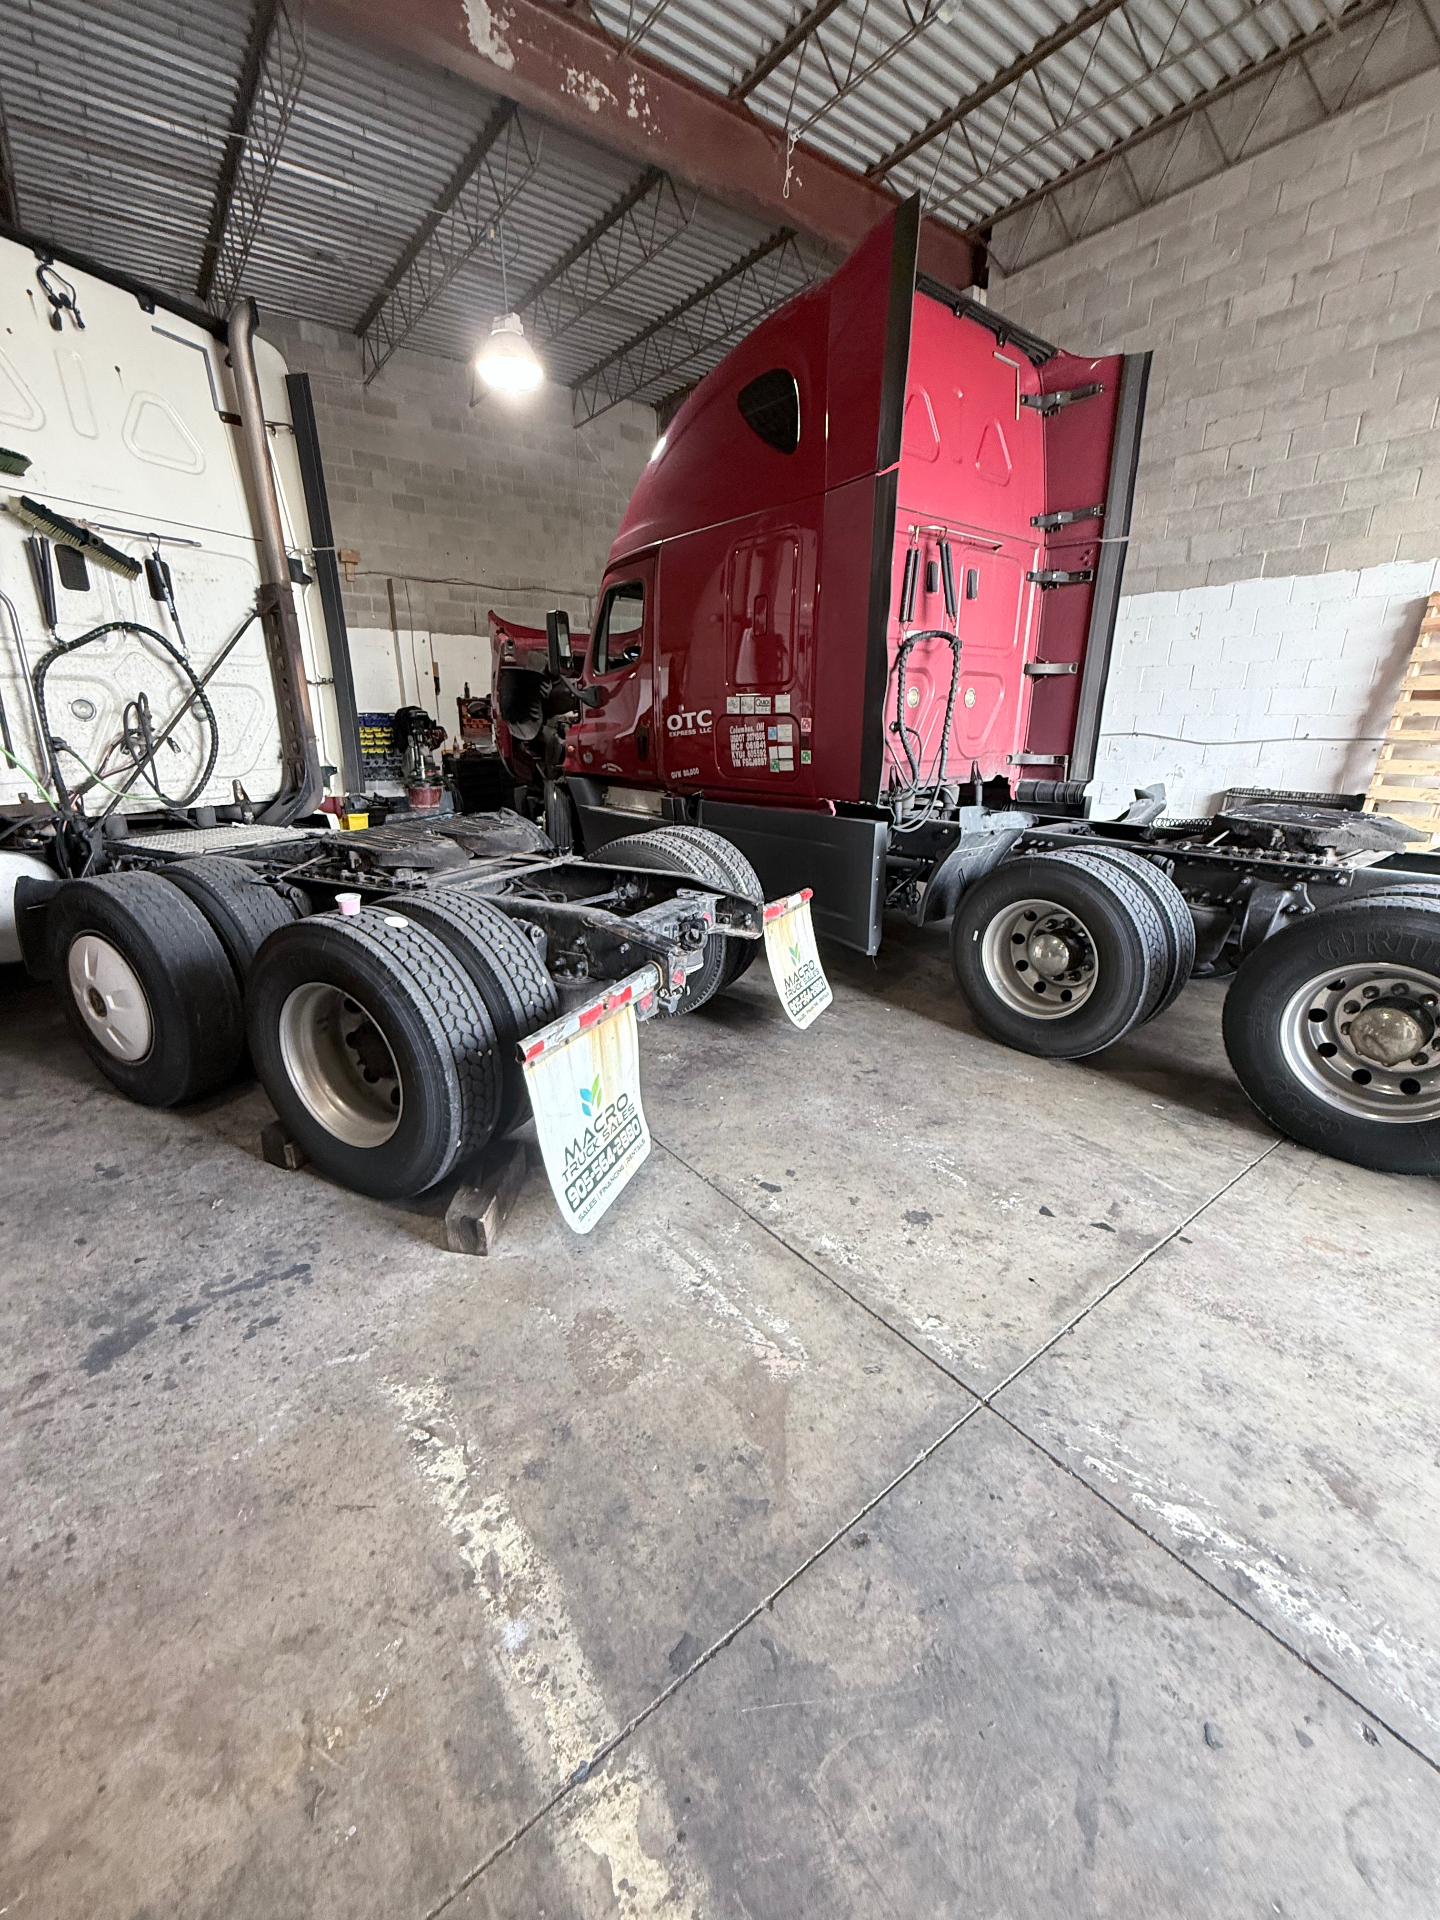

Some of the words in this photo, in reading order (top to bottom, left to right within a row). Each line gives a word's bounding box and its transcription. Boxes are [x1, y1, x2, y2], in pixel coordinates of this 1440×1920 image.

[667, 709, 713, 731] OTC
[669, 729, 697, 737] EXPRESS
[756, 722, 765, 731] OH
[730, 734, 744, 742] USDOT
[783, 959, 815, 991] MACRO
[784, 980, 804, 999] TRUCK
[803, 967, 820, 985] SALES
[561, 1136, 602, 1183] TRUCK
[602, 1102, 635, 1143] SALES
[564, 1092, 629, 1167] MACRO
[566, 1116, 642, 1209] 905-564-2880
[577, 1197, 598, 1223] SALES
[599, 1163, 626, 1198] FINANCING
[626, 1138, 646, 1163] RENTALS
